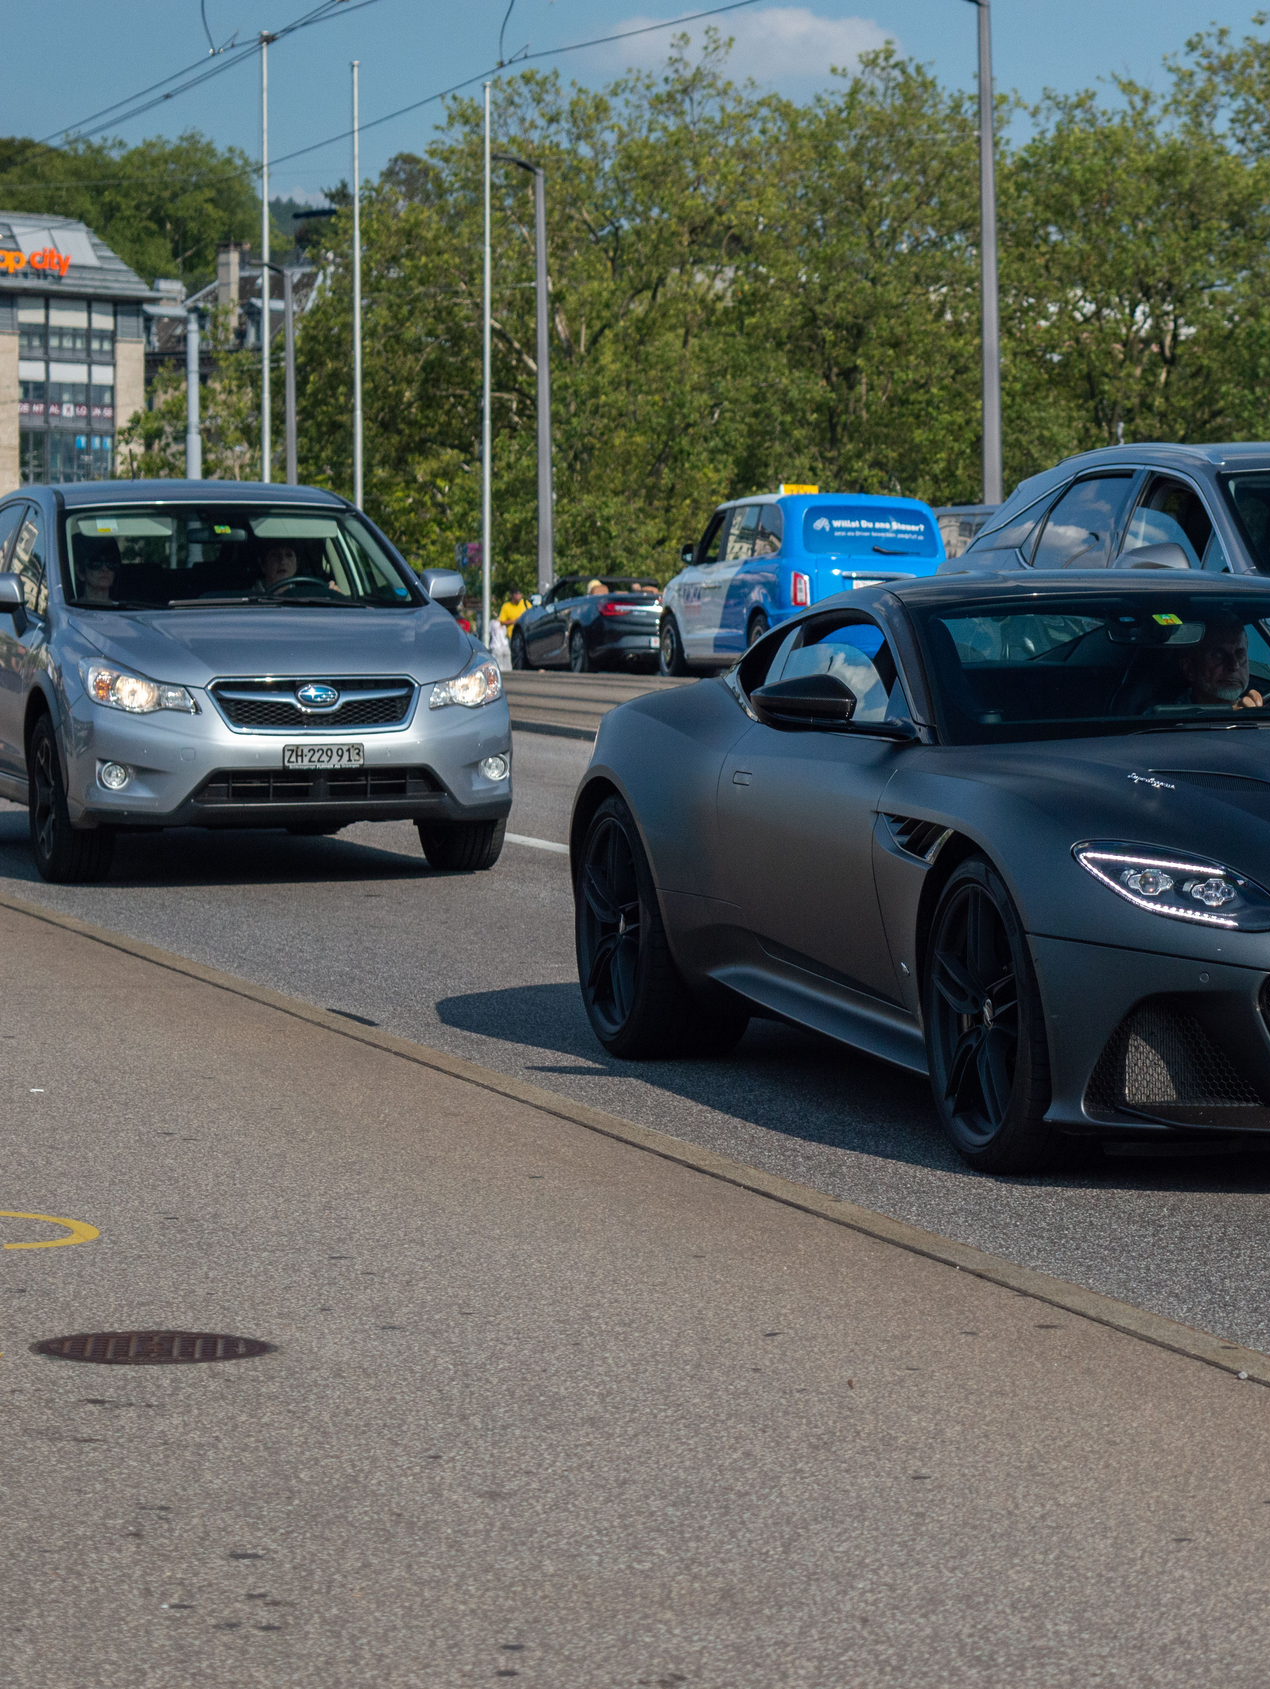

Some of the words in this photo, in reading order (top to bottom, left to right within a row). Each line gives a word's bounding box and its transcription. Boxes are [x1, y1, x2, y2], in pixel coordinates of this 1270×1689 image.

[29, 247, 71, 276] city
[832, 519, 860, 528] Willst
[861, 519, 873, 528] Du
[891, 521, 925, 532] Steuer?
